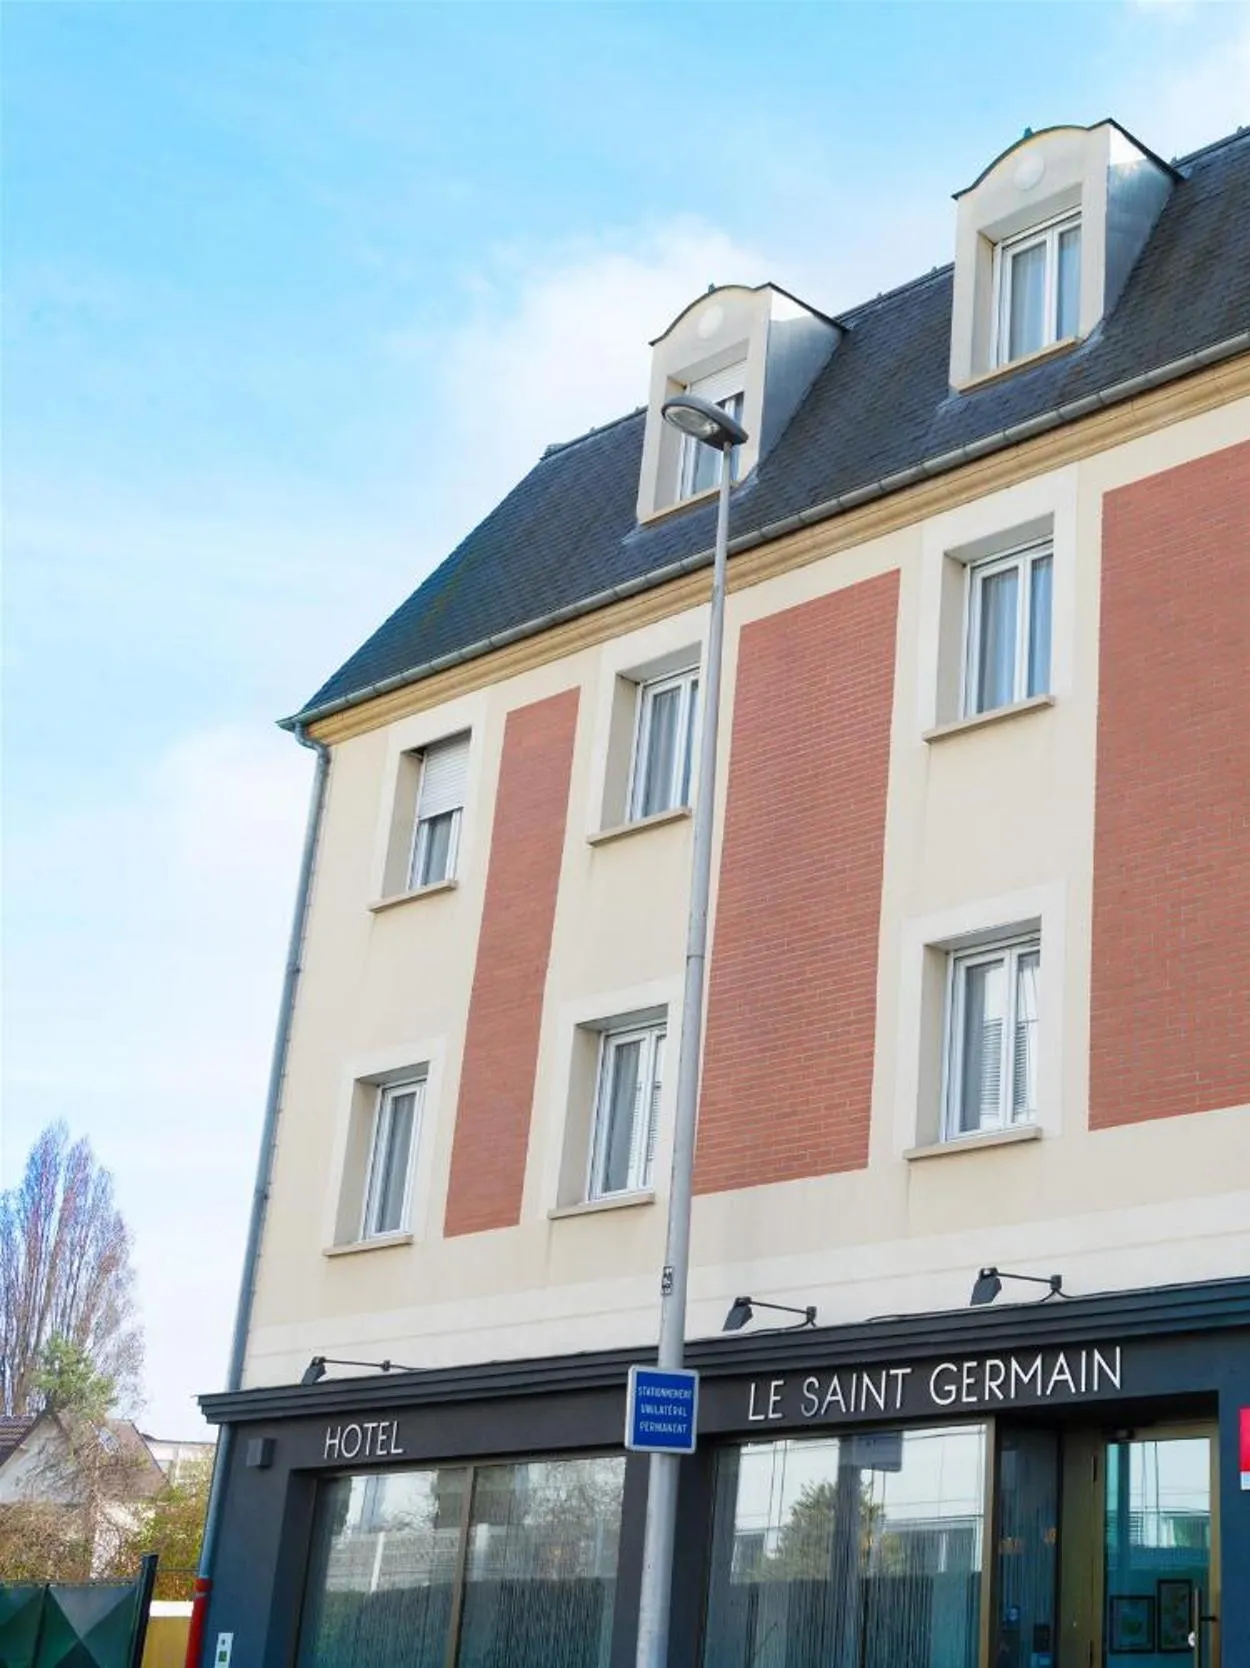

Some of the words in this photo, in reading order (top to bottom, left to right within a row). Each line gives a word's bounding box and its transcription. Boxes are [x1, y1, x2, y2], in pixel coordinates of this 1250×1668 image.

[748, 1380, 785, 1421] LE
[801, 1367, 913, 1418] SAINT
[929, 1345, 1121, 1406] GERMAIN
[324, 1420, 404, 1460] HOTEL
[639, 1420, 688, 1434] PERMANENT
